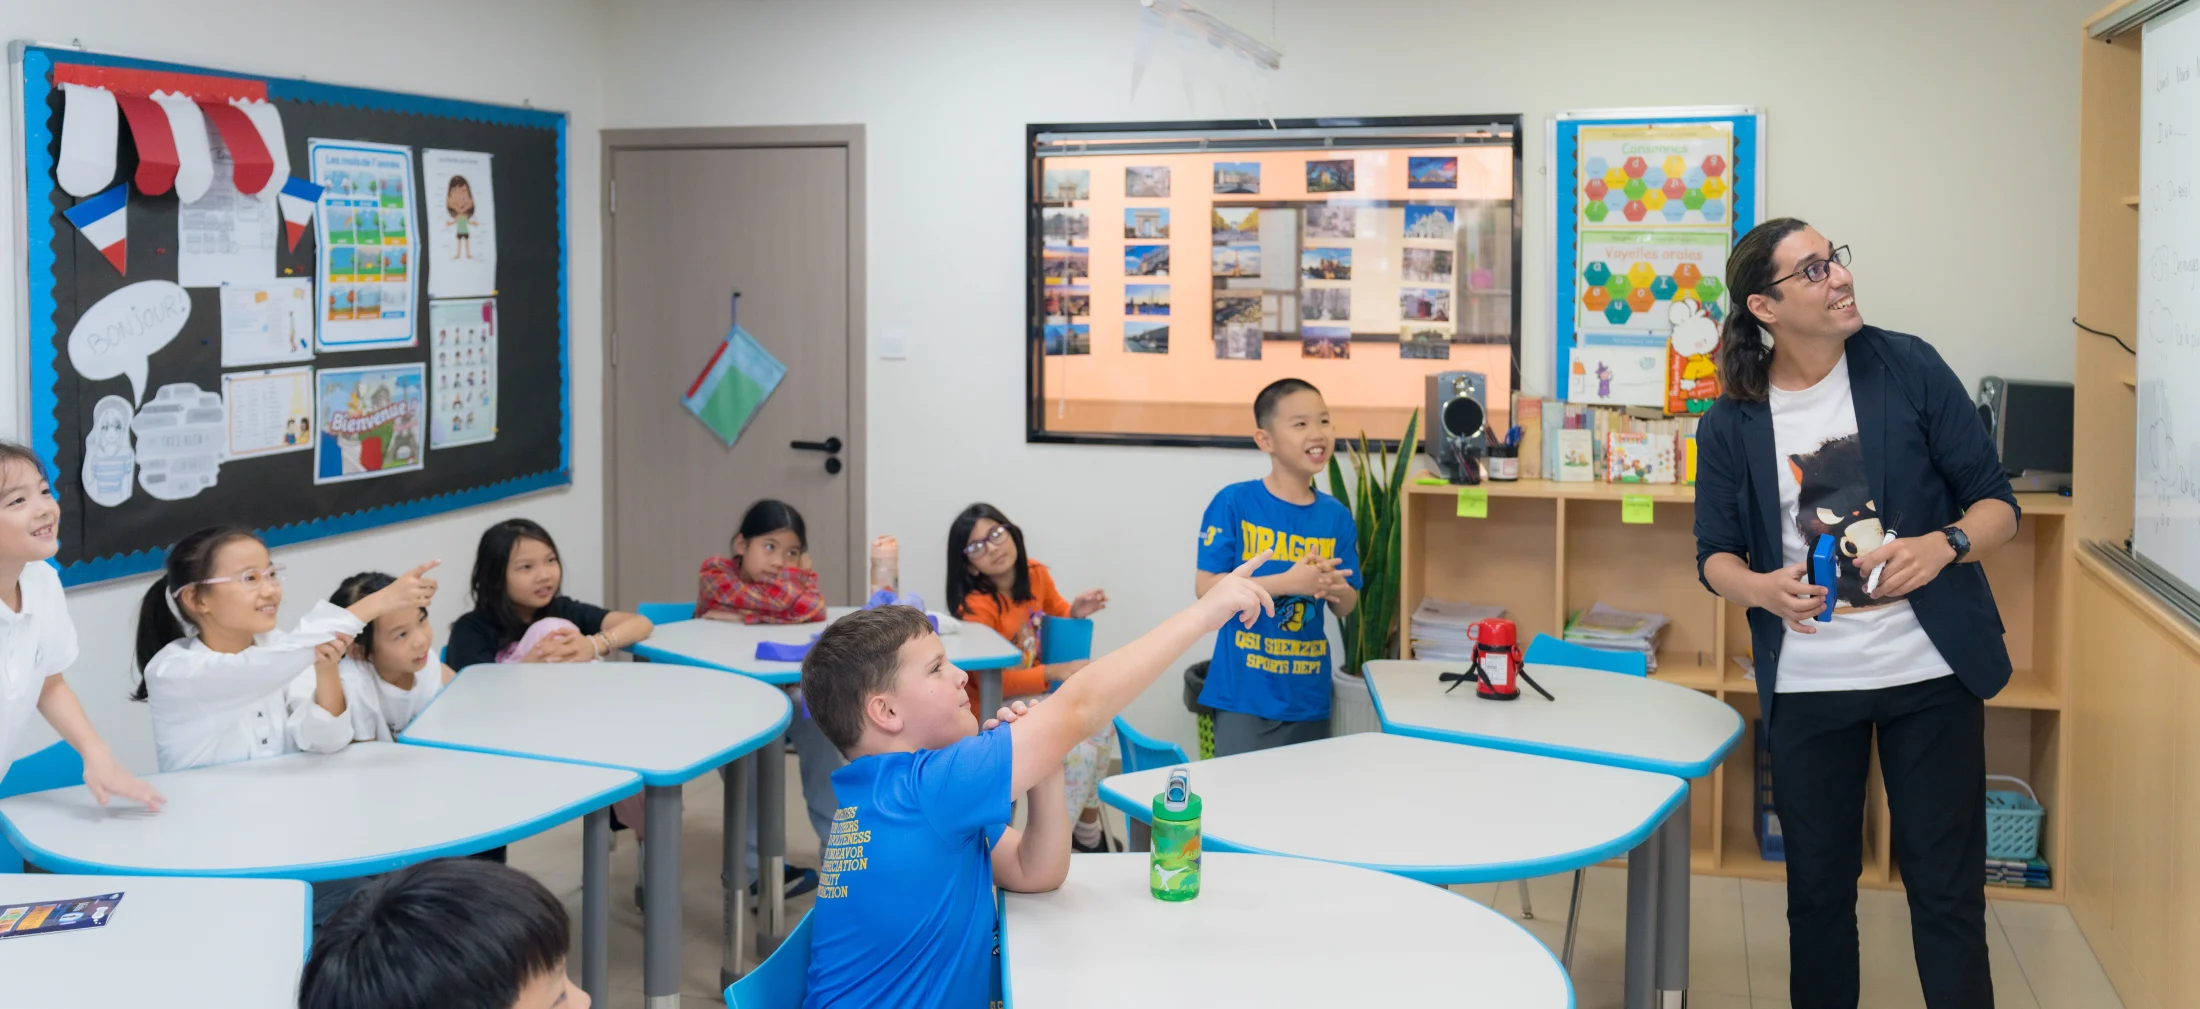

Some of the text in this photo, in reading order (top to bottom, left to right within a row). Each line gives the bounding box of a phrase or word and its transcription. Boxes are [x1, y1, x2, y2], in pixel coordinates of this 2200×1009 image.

[331, 400, 406, 434] Bienvenue
[1235, 630, 1261, 650] QSI
[1246, 653, 1321, 674] SPORTS DEPT
